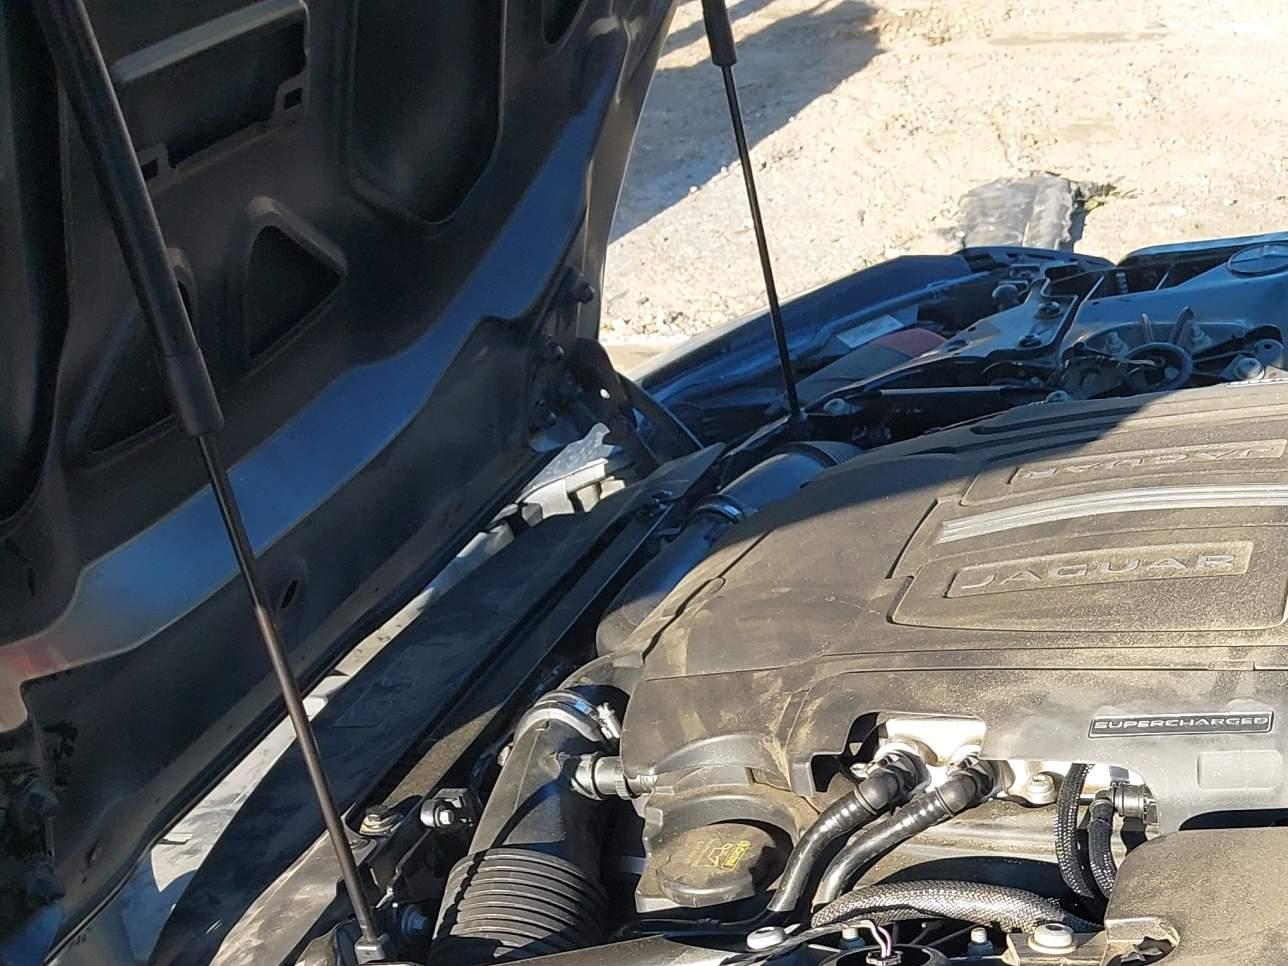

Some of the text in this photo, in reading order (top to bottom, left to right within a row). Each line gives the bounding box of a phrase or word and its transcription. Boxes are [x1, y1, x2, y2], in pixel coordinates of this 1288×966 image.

[1022, 446, 1277, 480] JAGUAR
[960, 553, 1237, 590] JAGUAR
[1093, 716, 1269, 730] SUPERCHARGED
